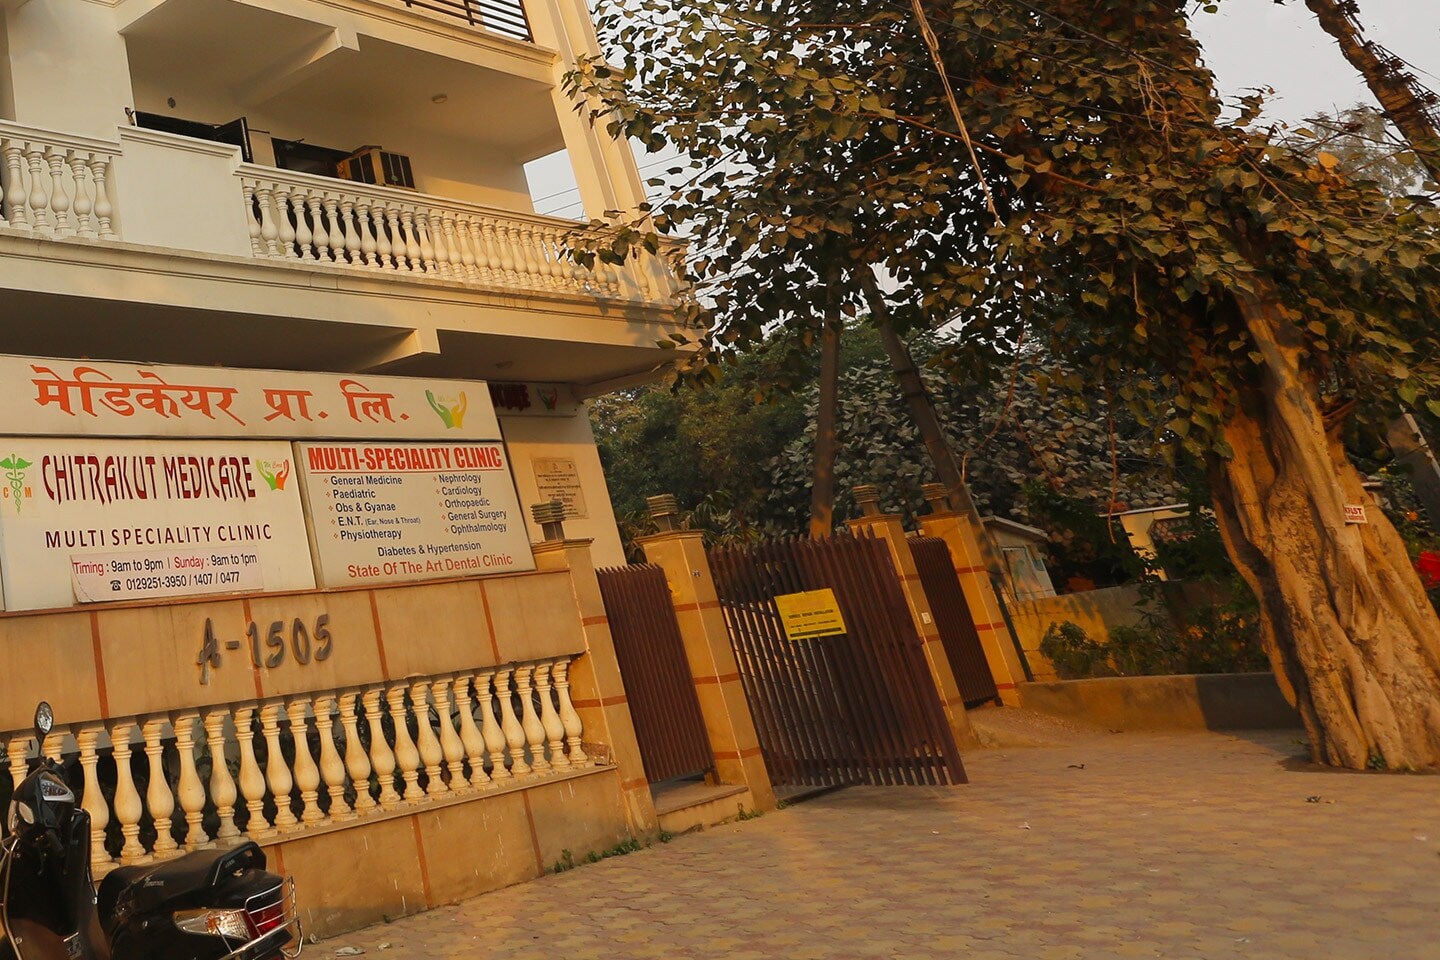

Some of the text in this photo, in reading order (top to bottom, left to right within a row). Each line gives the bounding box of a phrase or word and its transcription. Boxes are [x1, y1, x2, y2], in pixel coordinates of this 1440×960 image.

[30, 364, 246, 426] मेडिकेयर
[262, 389, 328, 421] प्रा.
[339, 379, 410, 423] लि.
[308, 447, 502, 470] MULTI-SPECIALITY CLINIC
[42, 455, 256, 505] CHITRAKUT MEDICARE
[330, 475, 402, 486] General Medicine
[439, 474, 481, 484] Nephrology
[333, 489, 376, 499] Paediatric
[442, 486, 481, 496] Cardiology
[335, 502, 396, 513] Obs & Gyanae
[445, 498, 490, 509] Orthopaedic
[338, 516, 363, 526] E.N.T.
[448, 510, 507, 521] General Surgery
[451, 522, 507, 535] Ophthalmology
[45, 524, 272, 548] MULTI SPECIALITY CLINIC
[340, 529, 402, 542] Physiotherapy
[378, 542, 481, 557] Diabetes & Hypertension
[73, 562, 104, 576] Timing
[112, 560, 131, 572] 9am
[133, 560, 142, 570] to
[145, 559, 164, 573] 9pm
[175, 556, 204, 570] Sunday
[211, 554, 229, 566] 9am
[231, 555, 239, 564] to
[241, 553, 257, 566] 1pm
[348, 554, 513, 578] State Of The Art Dental Clinic
[126, 575, 186, 590] 0129251-3950
[194, 574, 212, 585] 1407
[220, 572, 239, 583] 0477
[196, 614, 332, 685] A-1505
